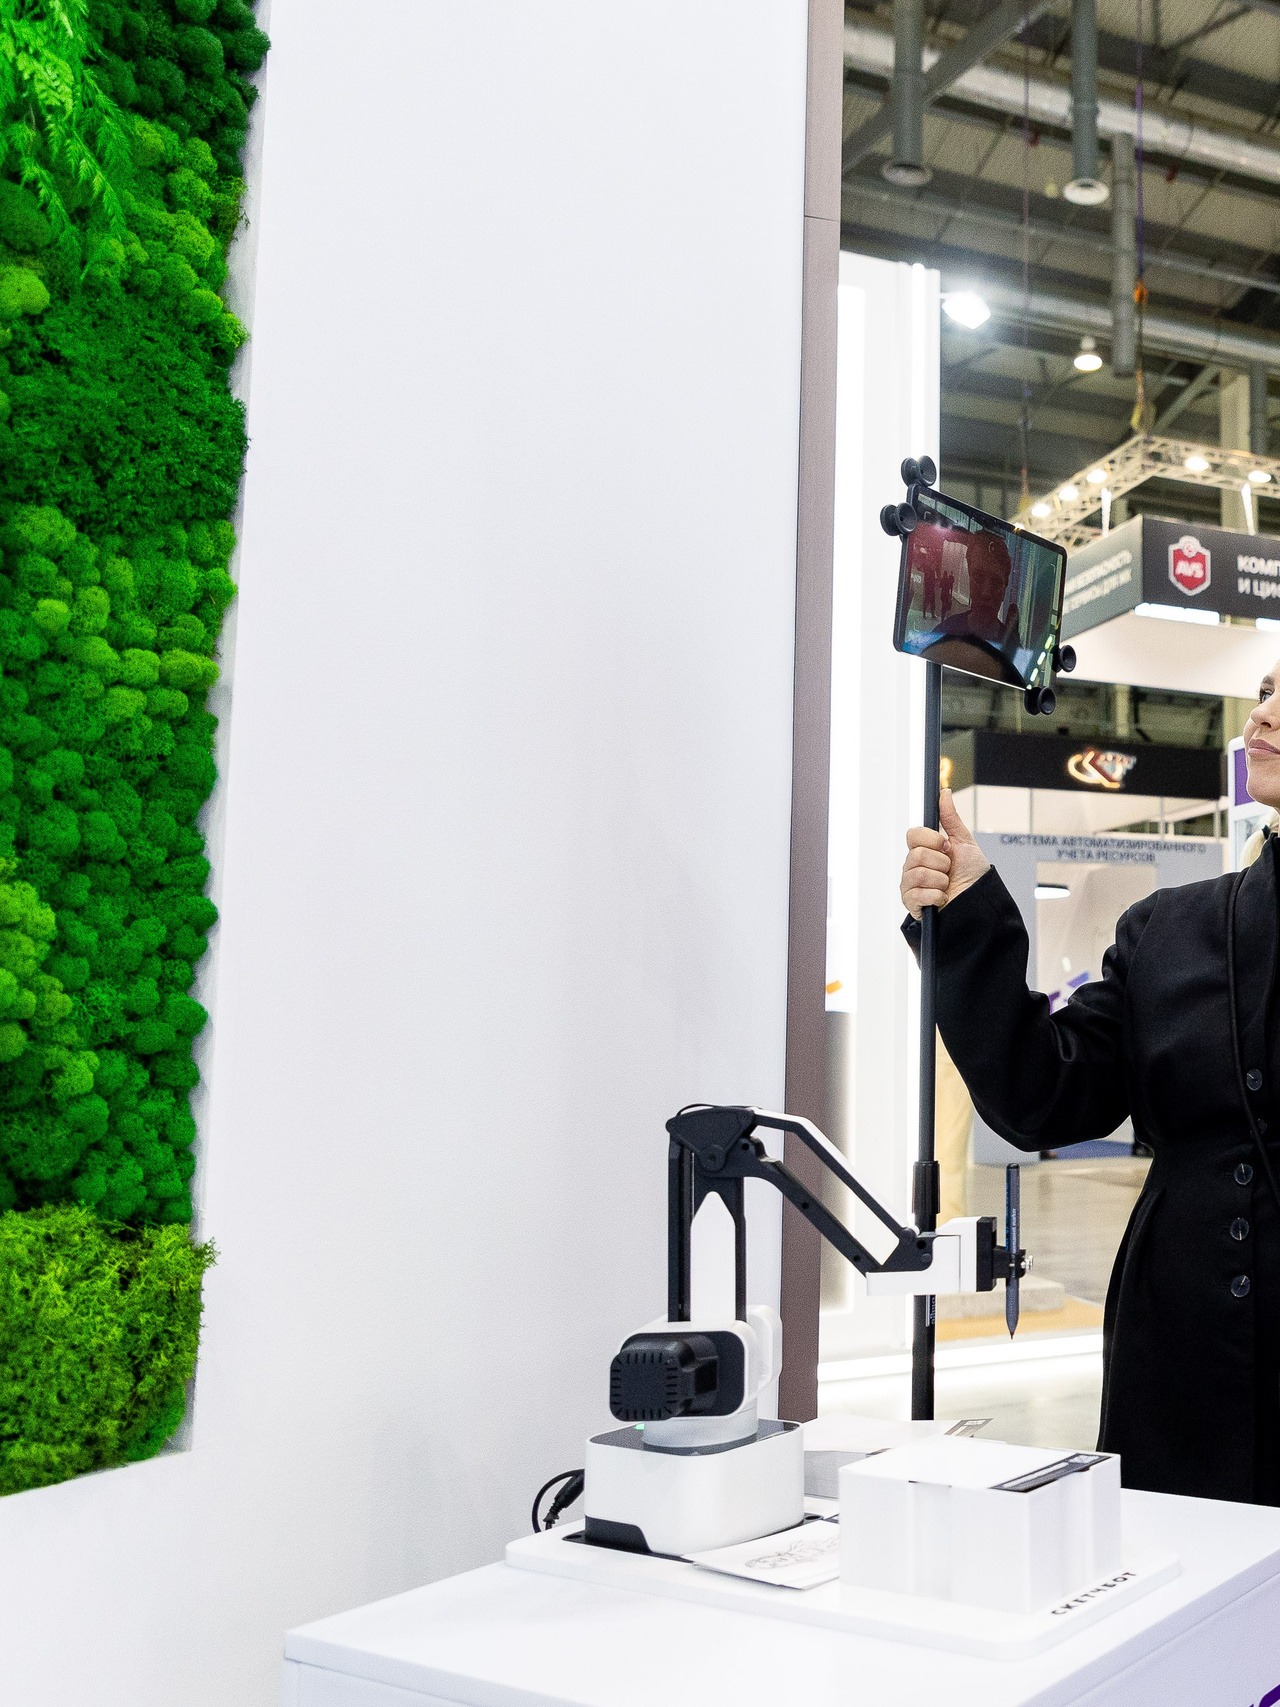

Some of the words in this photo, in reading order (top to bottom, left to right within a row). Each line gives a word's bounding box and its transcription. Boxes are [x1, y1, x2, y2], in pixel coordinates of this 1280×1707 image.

[1237, 578, 1251, 595] И
[1001, 834, 1058, 846] СИСТЕМА
[1051, 1572, 1137, 1615] СКЕТЧБОТ
